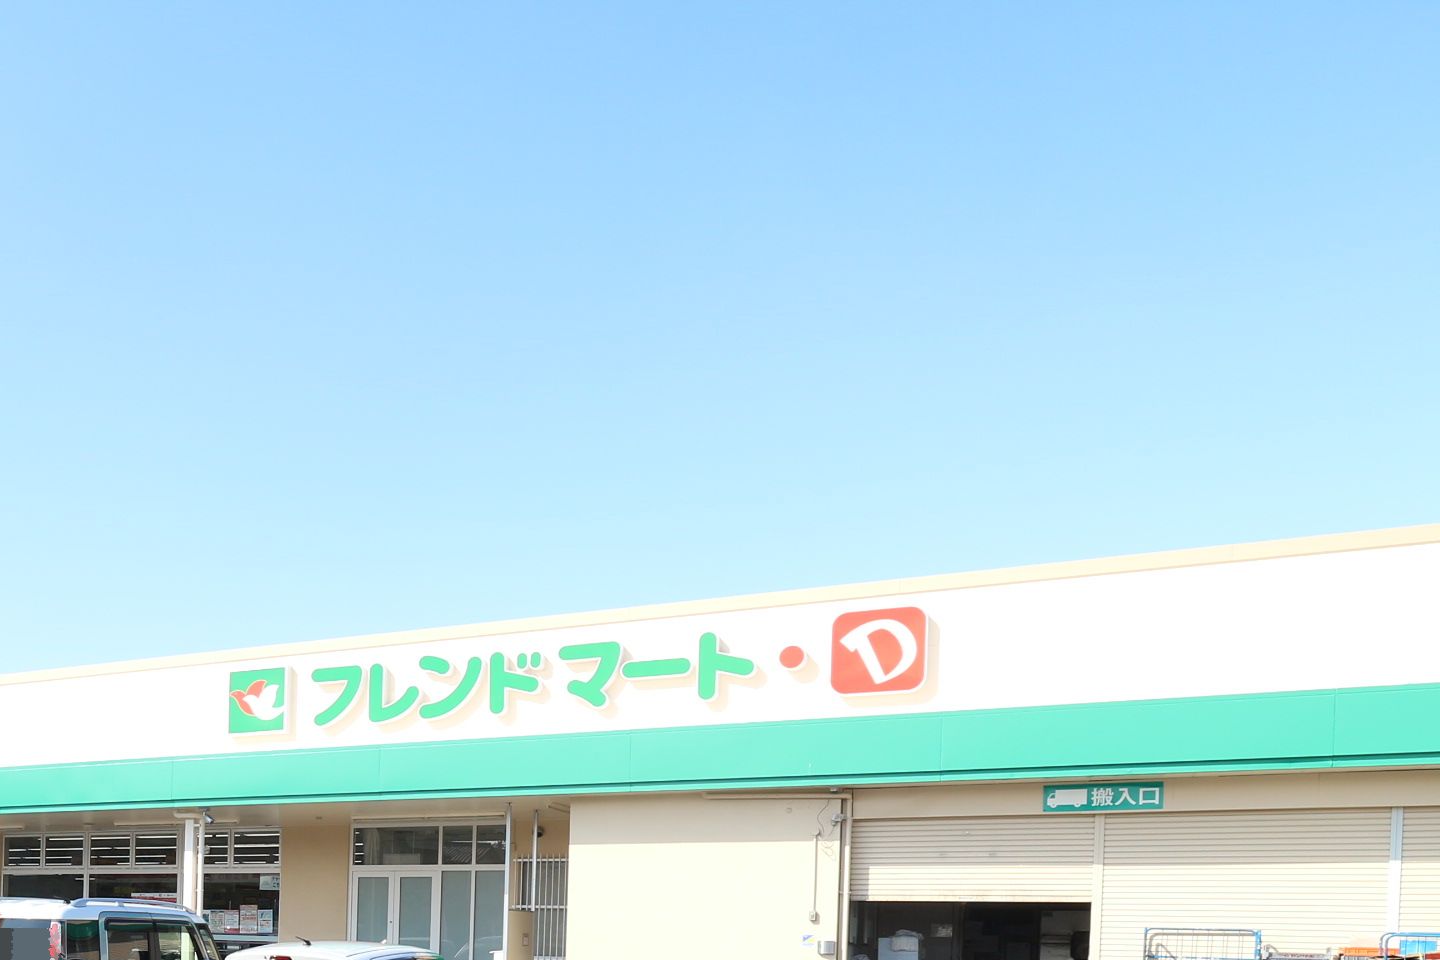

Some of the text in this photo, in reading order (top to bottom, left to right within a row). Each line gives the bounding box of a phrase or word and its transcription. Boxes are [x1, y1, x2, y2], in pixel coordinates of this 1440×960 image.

[311, 631, 755, 726] フレンドマート
[1091, 787, 1160, 807] 搬入口
